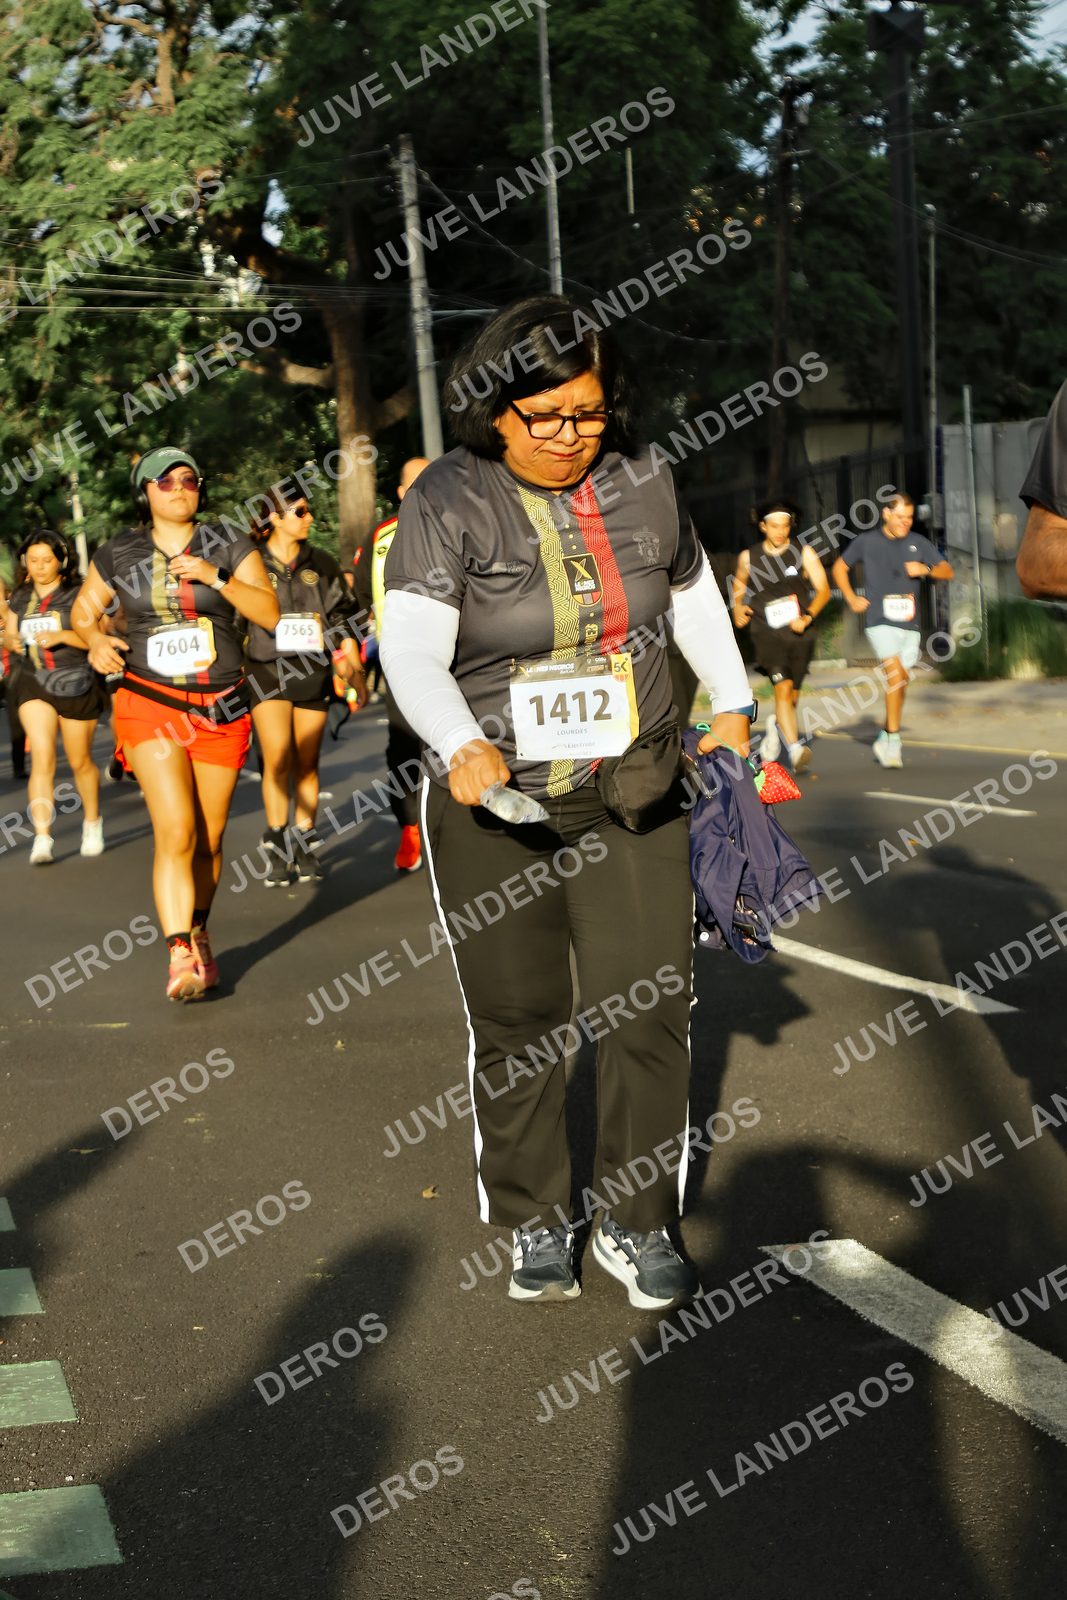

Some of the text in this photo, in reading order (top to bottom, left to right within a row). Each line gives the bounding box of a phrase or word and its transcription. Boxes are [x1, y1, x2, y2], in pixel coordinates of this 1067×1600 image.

[284, 624, 314, 636] 7565
[155, 635, 200, 657] 7604
[529, 688, 612, 726] 1412
[556, 728, 589, 736] LOURDES
